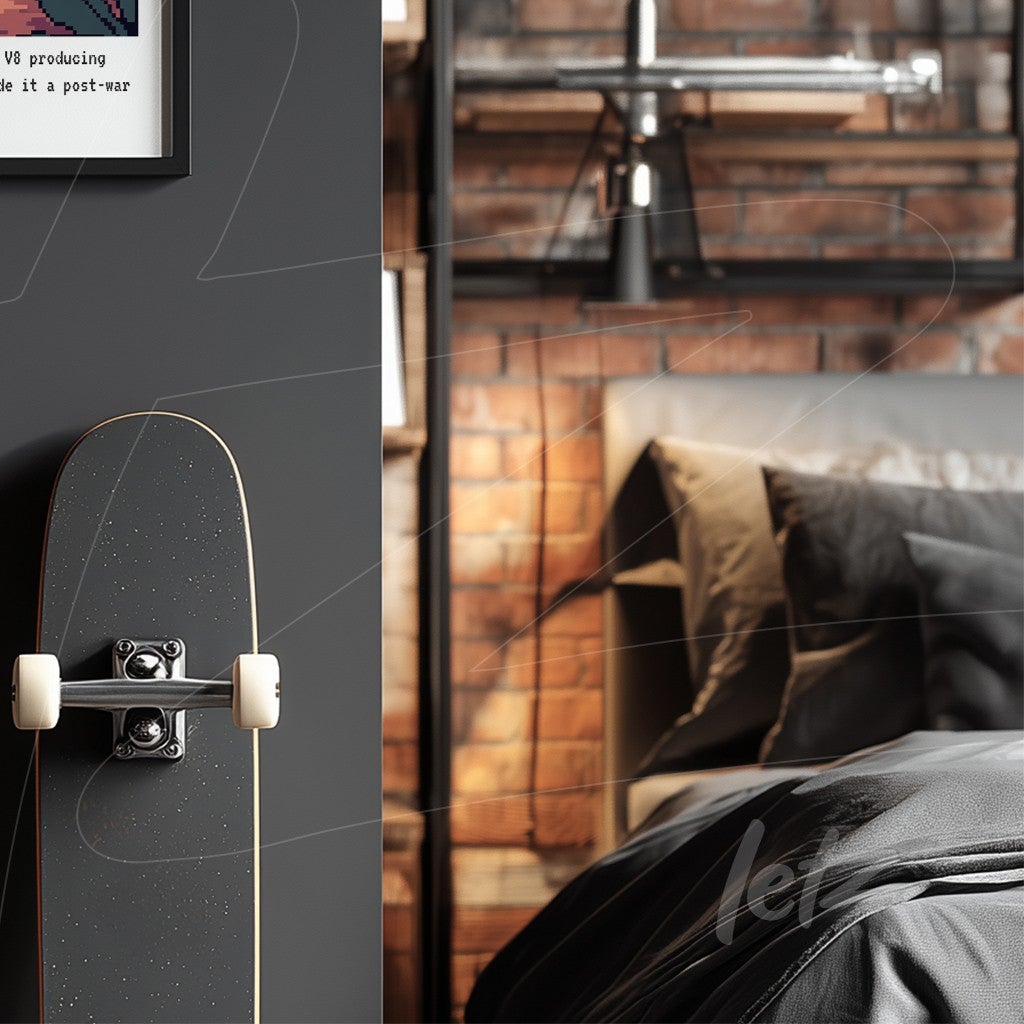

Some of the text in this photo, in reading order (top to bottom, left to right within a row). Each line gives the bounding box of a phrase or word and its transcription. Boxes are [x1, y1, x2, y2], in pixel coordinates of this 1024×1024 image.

[4, 50, 21, 65] V8
[29, 50, 106, 68] producing
[22, 78, 37, 92] it
[46, 81, 55, 92] a
[63, 78, 131, 96] post-war
